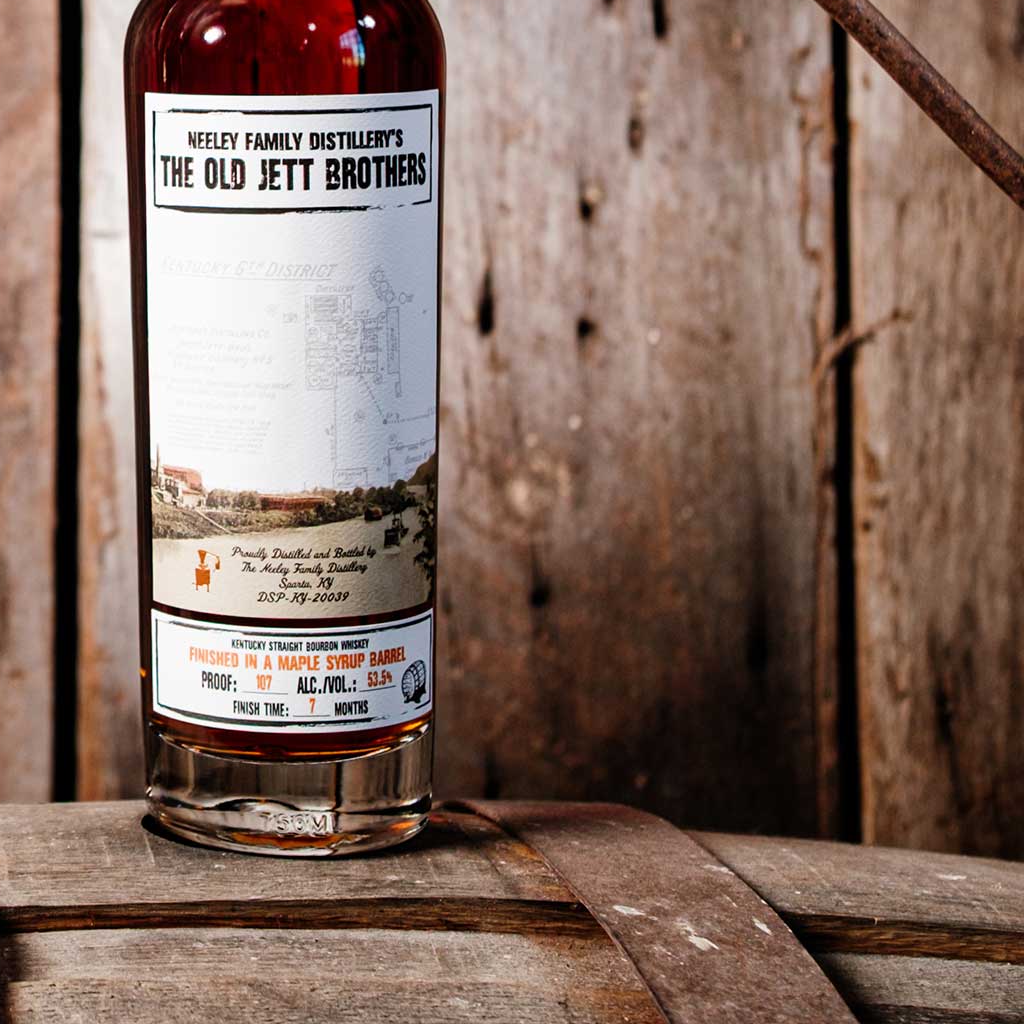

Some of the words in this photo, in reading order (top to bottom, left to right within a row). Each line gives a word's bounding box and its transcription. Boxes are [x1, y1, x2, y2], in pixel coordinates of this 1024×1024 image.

[188, 131, 239, 150] NEELEY
[245, 132, 303, 151] FAMILY
[309, 129, 404, 151] DISTILLERY'S
[160, 155, 194, 188] THE
[204, 157, 246, 190] OLD
[258, 158, 314, 191] JETT
[326, 152, 427, 191] BROTHERS
[231, 546, 268, 562] Proudly
[271, 547, 311, 559] Distilled
[313, 547, 330, 559] and
[333, 546, 365, 559] Bottled
[366, 545, 377, 558] by
[241, 561, 257, 573] The
[259, 562, 290, 576] Neeley
[293, 562, 323, 576] Family
[327, 562, 368, 575] Distillery
[278, 577, 312, 590] Sparta,
[317, 577, 335, 591] KY
[257, 591, 350, 607] DSP-KY-20039
[231, 638, 266, 651] KENTUCKY
[269, 640, 303, 652] STRAIGHT
[306, 640, 338, 652] BOURBON
[341, 638, 369, 651] WHISKEY
[189, 646, 239, 668] FINISHED
[245, 654, 257, 670] IN
[263, 655, 273, 671] A
[278, 655, 320, 672] MAPLE
[326, 653, 365, 671] SYRUP
[369, 646, 406, 667] BARREL
[201, 671, 238, 693] PROOF:
[255, 674, 273, 691] 107
[233, 700, 261, 716] FINISH
[264, 701, 289, 717] TIME:
[309, 698, 316, 714] 7
[334, 700, 369, 716] MONTHS
